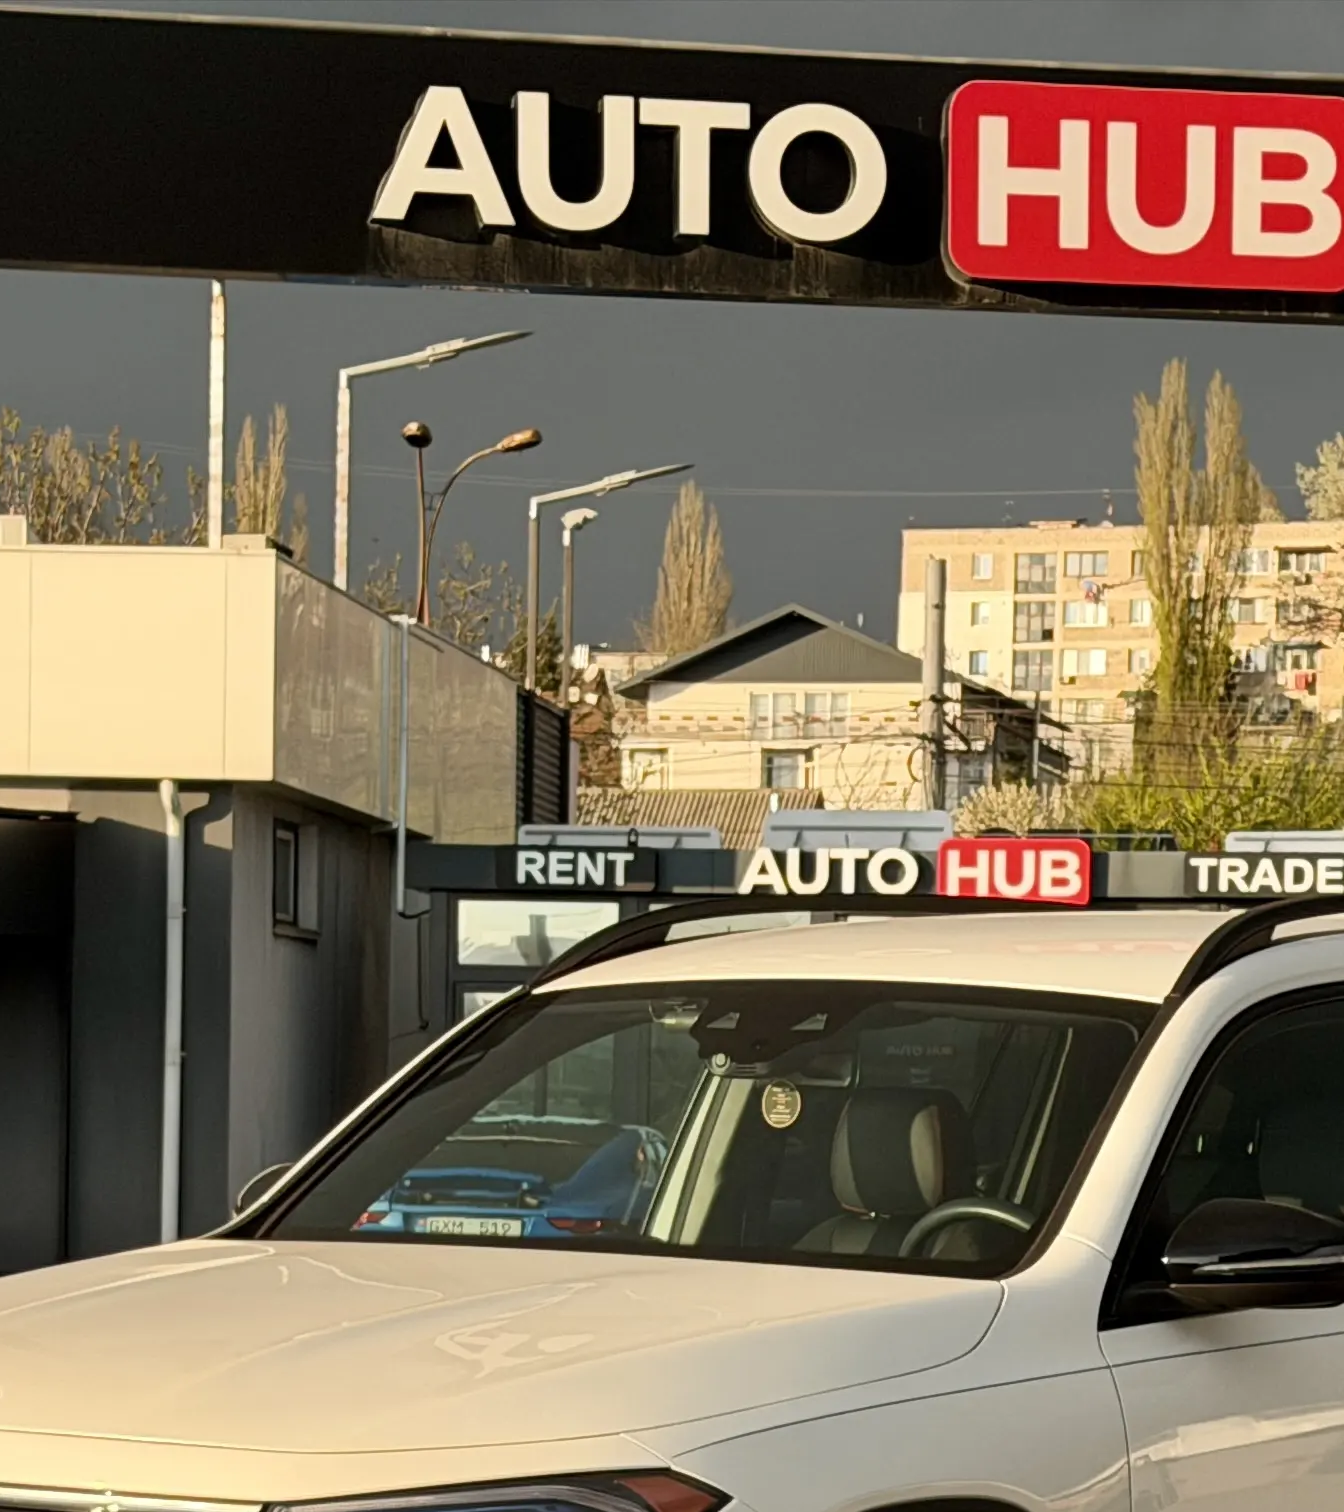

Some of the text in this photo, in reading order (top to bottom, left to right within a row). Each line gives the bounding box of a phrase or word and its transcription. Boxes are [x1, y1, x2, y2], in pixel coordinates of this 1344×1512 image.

[368, 85, 1342, 258] AUTO HUB
[516, 850, 635, 887] RENT
[737, 848, 1082, 898] AUTO HUB
[1188, 857, 1344, 894] TRADE
